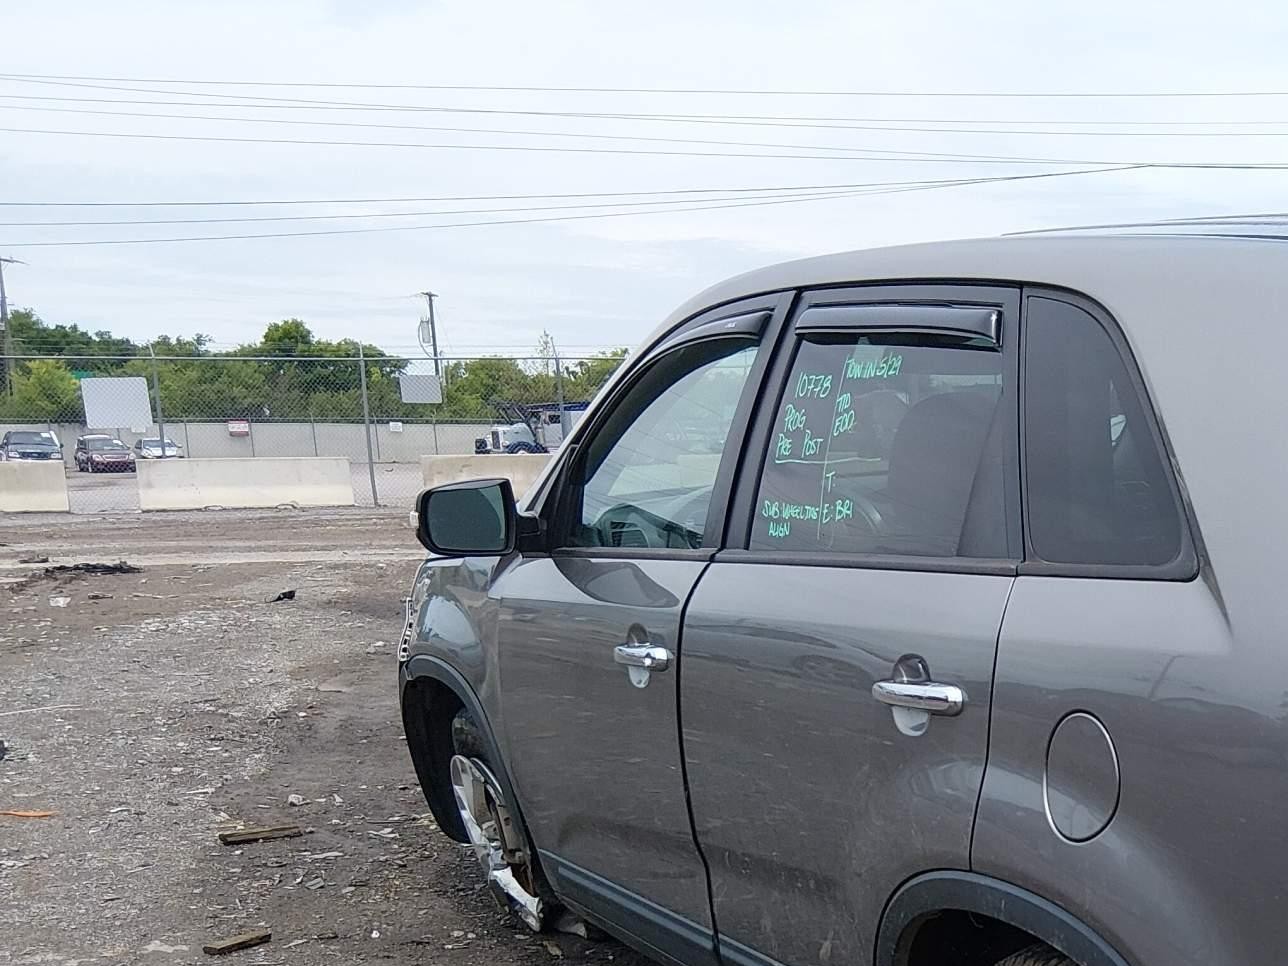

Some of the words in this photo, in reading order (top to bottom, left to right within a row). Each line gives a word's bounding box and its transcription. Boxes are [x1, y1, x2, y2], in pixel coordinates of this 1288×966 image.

[795, 372, 832, 398] 10778
[784, 404, 806, 432] PROG
[776, 433, 792, 458] PRE
[801, 430, 824, 457] POST
